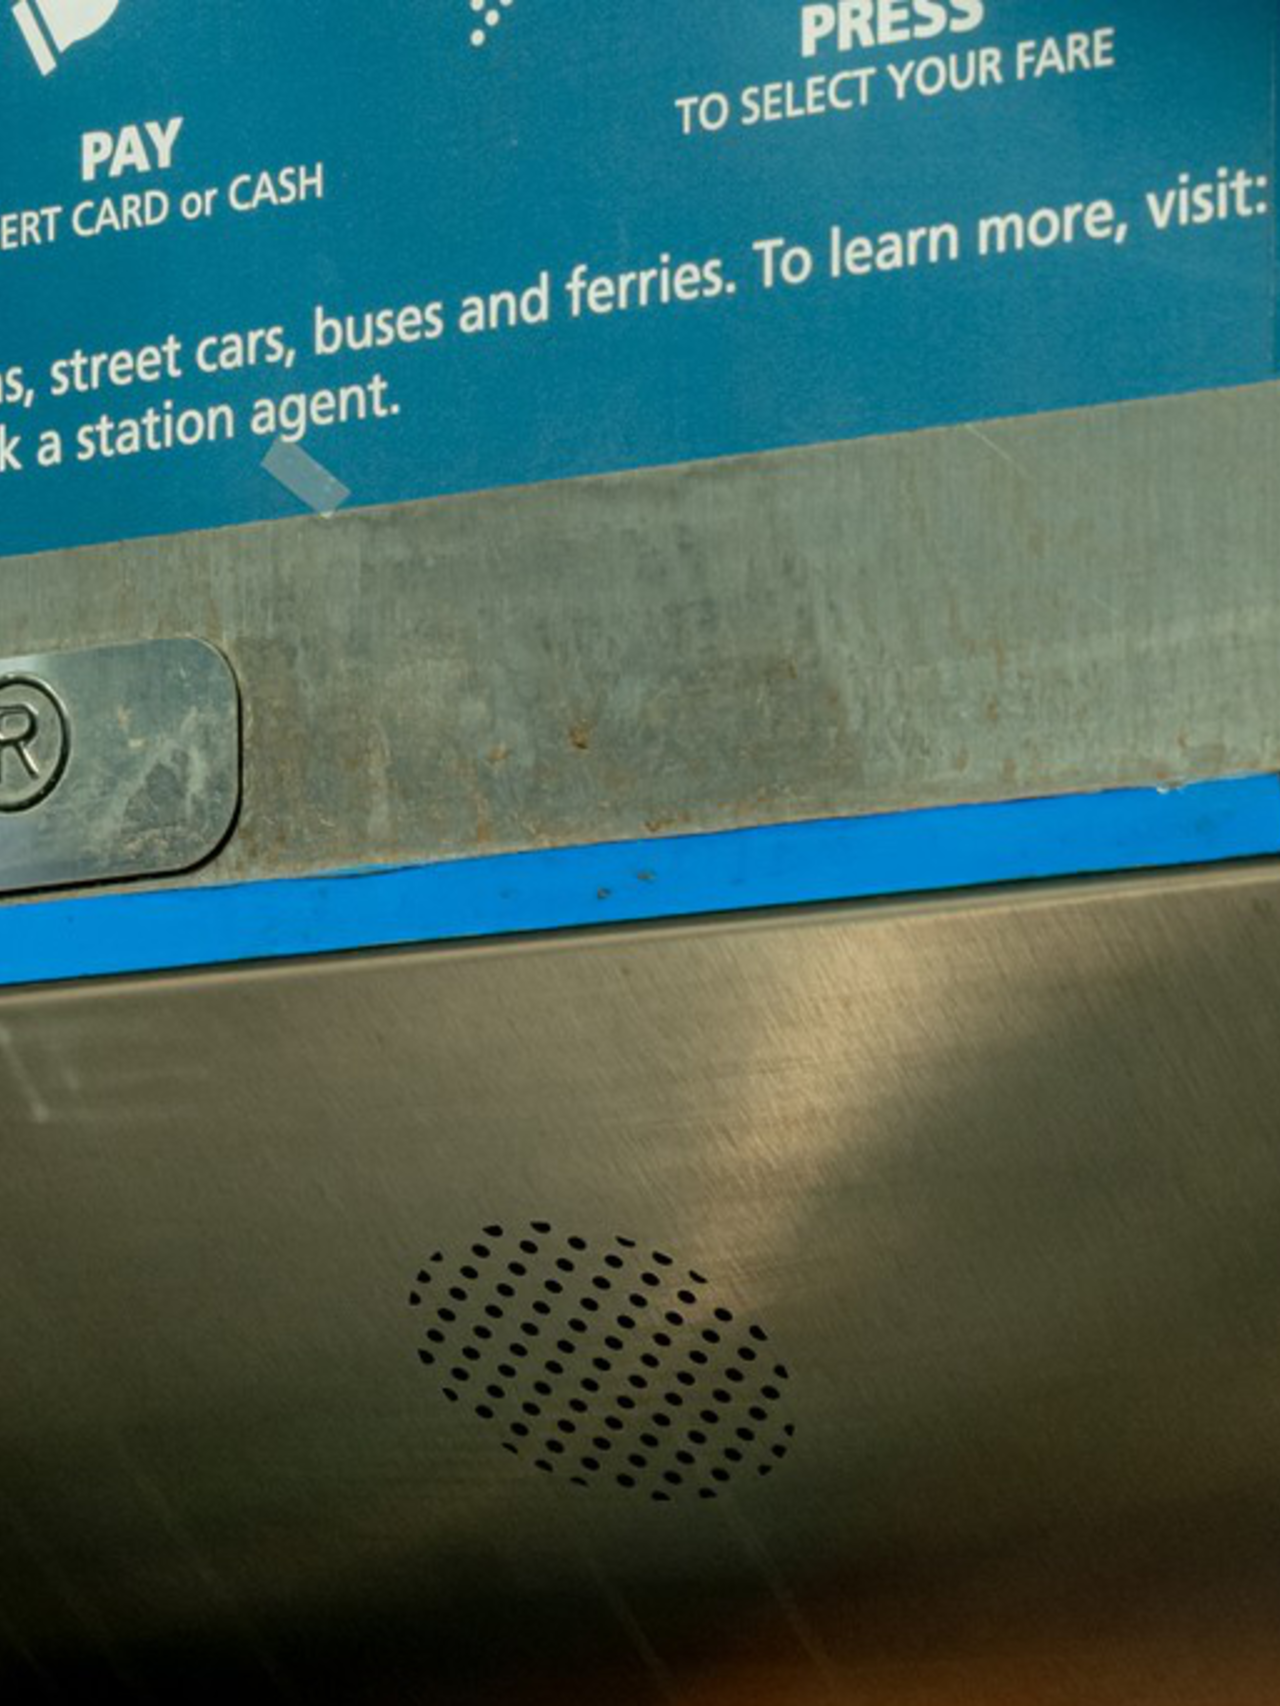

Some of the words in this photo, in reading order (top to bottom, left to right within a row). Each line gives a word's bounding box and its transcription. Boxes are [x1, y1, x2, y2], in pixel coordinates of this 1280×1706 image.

[801, 0, 984, 57] PRESS
[676, 94, 729, 134] TO
[740, 67, 877, 125] SELECT
[887, 47, 1003, 100] YOUR
[1017, 27, 1116, 81] FARE
[81, 117, 184, 180] PAY
[72, 190, 169, 236] CARD
[181, 186, 218, 220] or
[228, 163, 325, 213] CASH
[50, 334, 182, 398] street
[196, 322, 298, 376] cars,
[314, 306, 444, 356] buses
[459, 274, 549, 334] and
[567, 255, 737, 318] ferries.
[753, 238, 812, 290] To
[829, 225, 959, 279] learn
[977, 197, 1129, 256] more,
[1146, 166, 1269, 231] visit:
[36, 437, 62, 468] a
[75, 403, 234, 463] station
[250, 373, 401, 443] agent.
